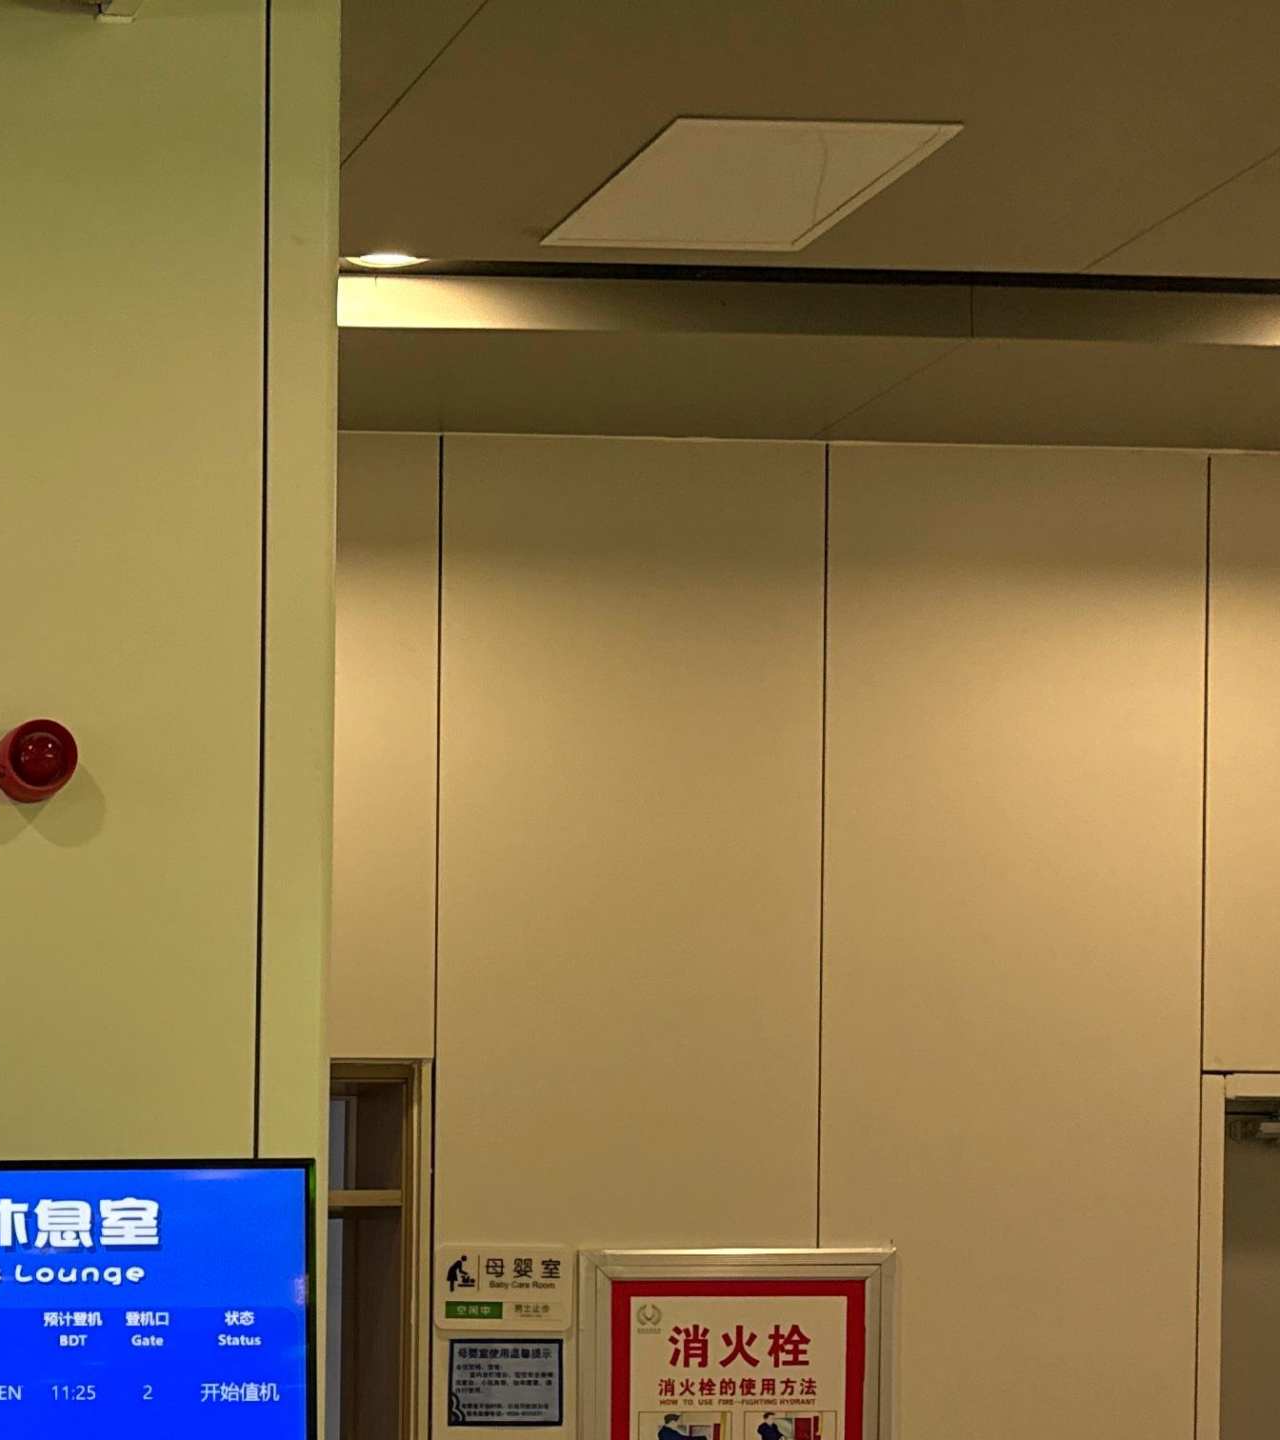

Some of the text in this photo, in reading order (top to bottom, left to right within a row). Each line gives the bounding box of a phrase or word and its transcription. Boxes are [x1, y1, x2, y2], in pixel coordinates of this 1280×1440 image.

[14, 1263, 146, 1286] Lounge
[485, 1258, 561, 1279] 母婴室
[489, 1281, 556, 1290] Baby Care Room
[44, 1311, 103, 1328] 预计登机
[126, 1311, 170, 1328] 登机口
[225, 1310, 255, 1327] 状态
[59, 1334, 88, 1347] BDT
[131, 1334, 165, 1347] Gate
[218, 1333, 262, 1347] Status
[668, 1324, 811, 1368] 消火栓
[50, 1384, 96, 1401] 11:25
[142, 1384, 153, 1401] 2
[200, 1383, 279, 1403] 开始值机
[658, 1378, 817, 1397] 消火栓的使用方法
